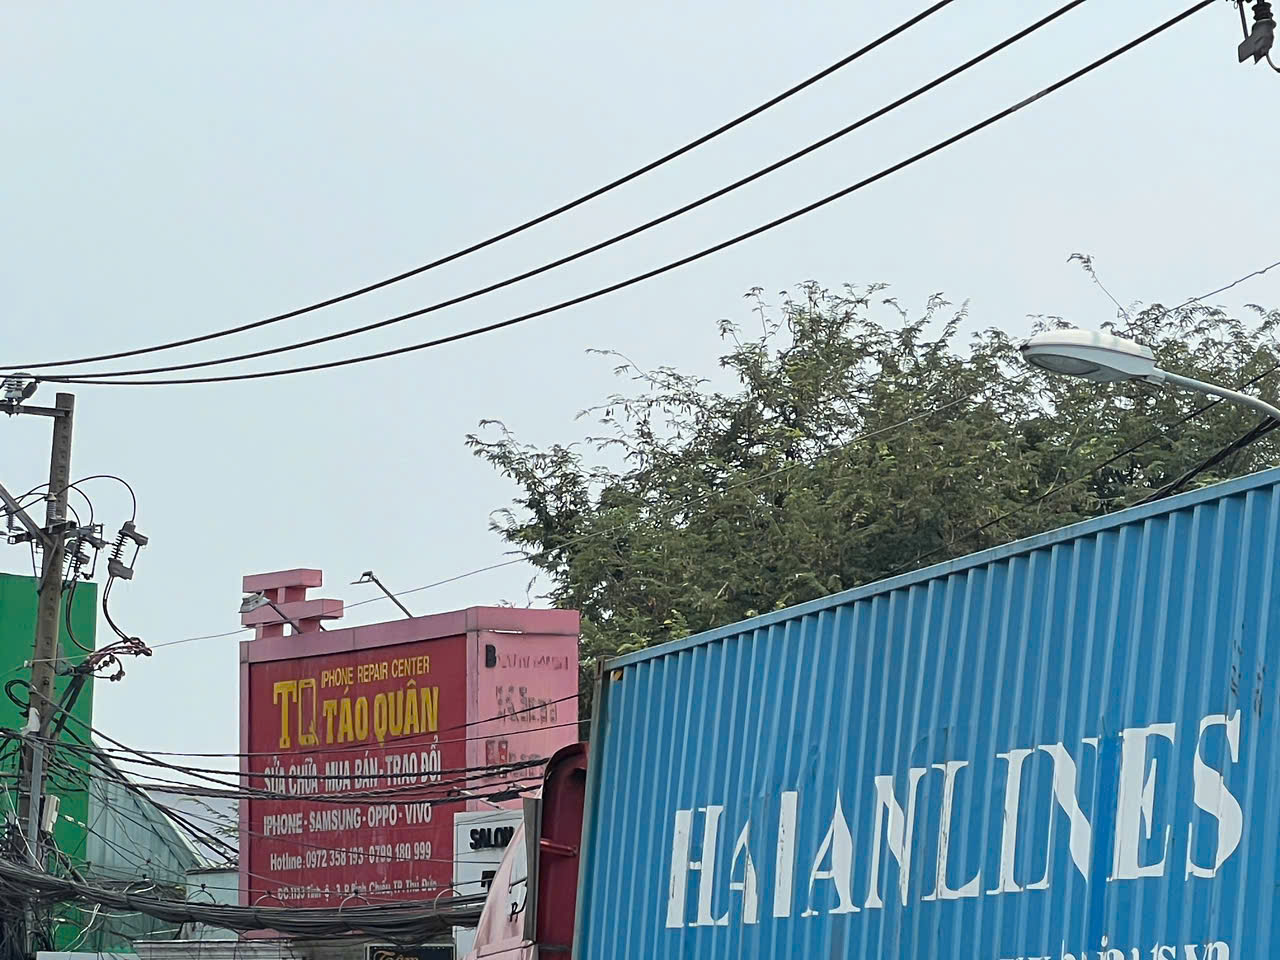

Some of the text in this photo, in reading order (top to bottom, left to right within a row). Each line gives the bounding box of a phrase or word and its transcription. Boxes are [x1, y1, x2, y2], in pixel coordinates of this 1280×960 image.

[321, 656, 430, 688] IPHONE REPAIR CENTER
[323, 685, 369, 744] TÁO
[373, 679, 439, 747] QUÂN
[264, 755, 286, 793] SỬA
[289, 757, 318, 795] CHỮA
[325, 760, 350, 792] MUA
[355, 750, 378, 789] BÁN
[385, 752, 417, 784] TRAO
[421, 735, 441, 783] ĐỔI
[264, 813, 303, 836] IPHONE
[309, 807, 361, 832] SAMSUNG
[367, 804, 397, 828] OPPO
[405, 803, 432, 824] VIVO
[329, 848, 347, 867] 358
[395, 842, 411, 862] 180
[414, 841, 432, 861] 999
